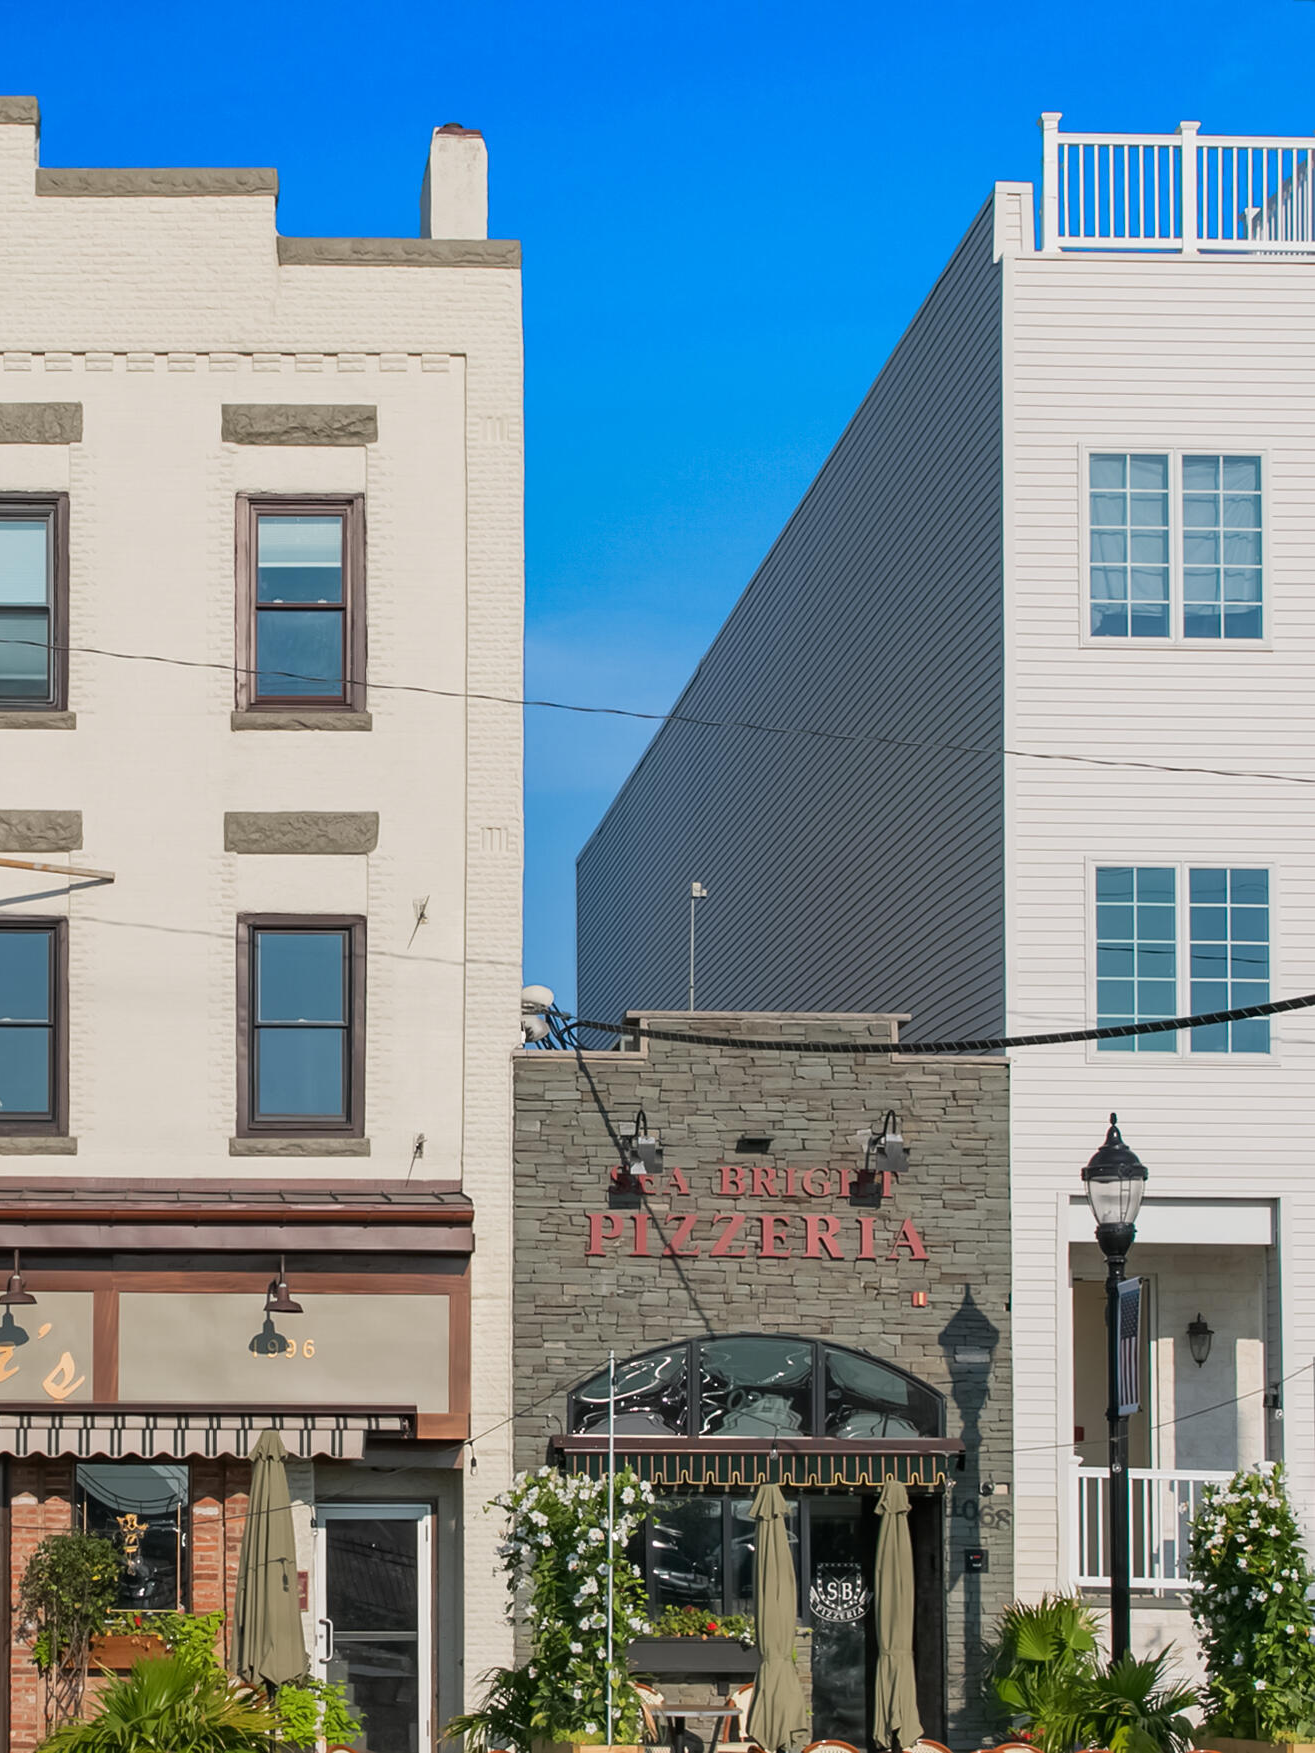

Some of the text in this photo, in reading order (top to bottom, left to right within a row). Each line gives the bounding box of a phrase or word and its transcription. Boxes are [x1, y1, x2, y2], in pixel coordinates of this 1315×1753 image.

[610, 1165, 902, 1198] SEA BRIGHT
[585, 1213, 930, 1261] PIZZERIA
[253, 1338, 316, 1359] 1996
[815, 1603, 865, 1620] PIZZERIA
